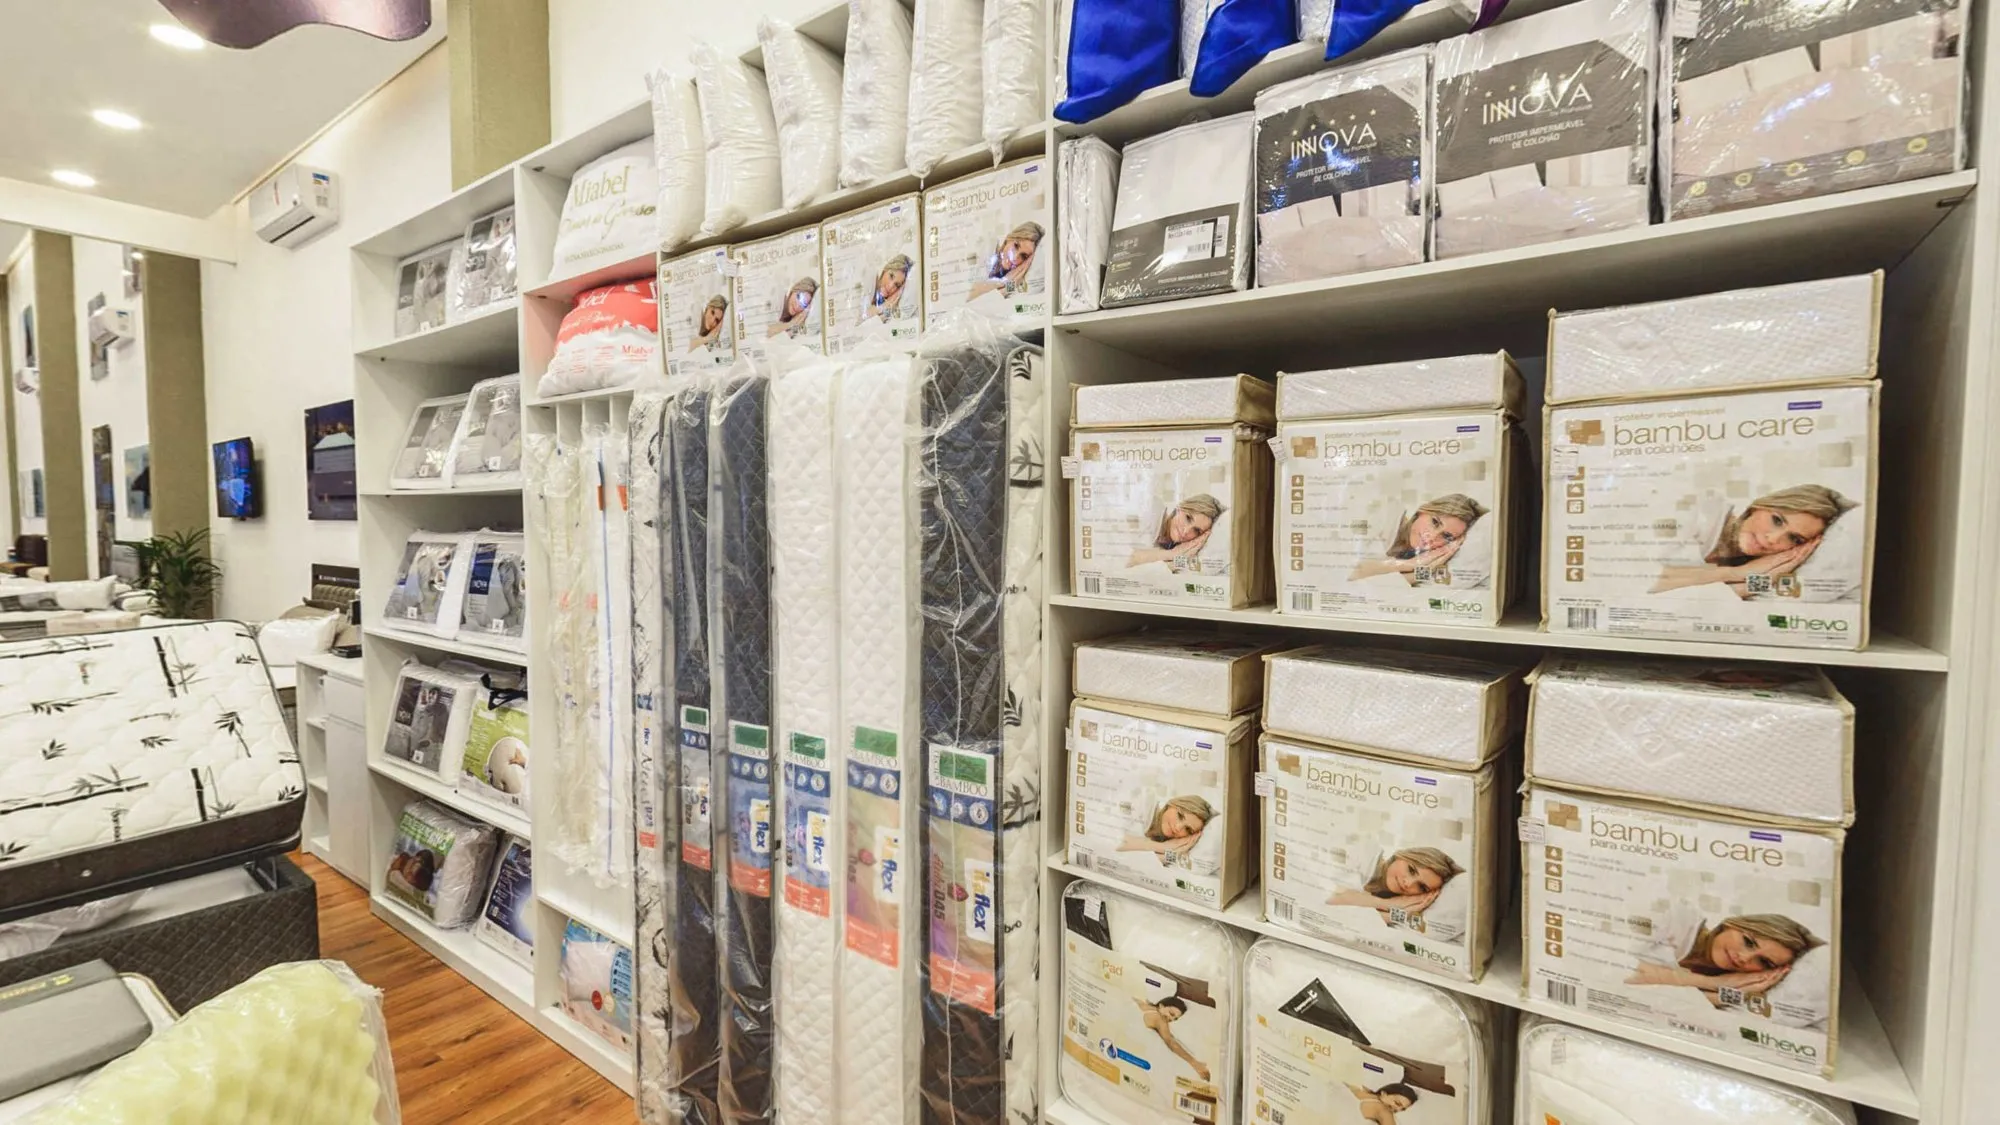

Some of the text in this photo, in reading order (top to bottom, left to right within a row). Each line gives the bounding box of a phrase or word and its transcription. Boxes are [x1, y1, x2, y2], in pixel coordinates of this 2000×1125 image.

[1483, 79, 1592, 125] INNOVA
[1291, 122, 1377, 160] INNOVA
[1488, 119, 1585, 145] PROTETOR IMPERMEÁVEL
[1512, 133, 1561, 149] DE COLCHÃO
[1296, 165, 1327, 179] PROTETOR
[1313, 175, 1322, 183] DE
[950, 188, 996, 210] bambu
[999, 179, 1030, 198] care
[1614, 407, 1726, 423] protetor impermeável
[1613, 415, 1815, 447] bambu care
[1105, 446, 1207, 462] bambu care
[1323, 438, 1461, 460] bambu care
[1613, 442, 1706, 458] para colchões
[1195, 583, 1225, 596] theva
[1442, 598, 1483, 613] theva
[1787, 614, 1849, 632] theva
[1102, 730, 1200, 762] bambu care
[940, 780, 988, 797] BAMBOO
[1306, 782, 1325, 793] para
[1307, 763, 1439, 809] bambu care
[1590, 815, 1784, 868] bambu care
[1590, 837, 1680, 861] para colchões
[1184, 880, 1216, 897] theva
[973, 869, 991, 931] itaflex
[1416, 944, 1457, 967] theva
[1102, 959, 1124, 976] Pad
[1303, 1035, 1332, 1057] Pad
[1759, 1031, 1817, 1058] theva
